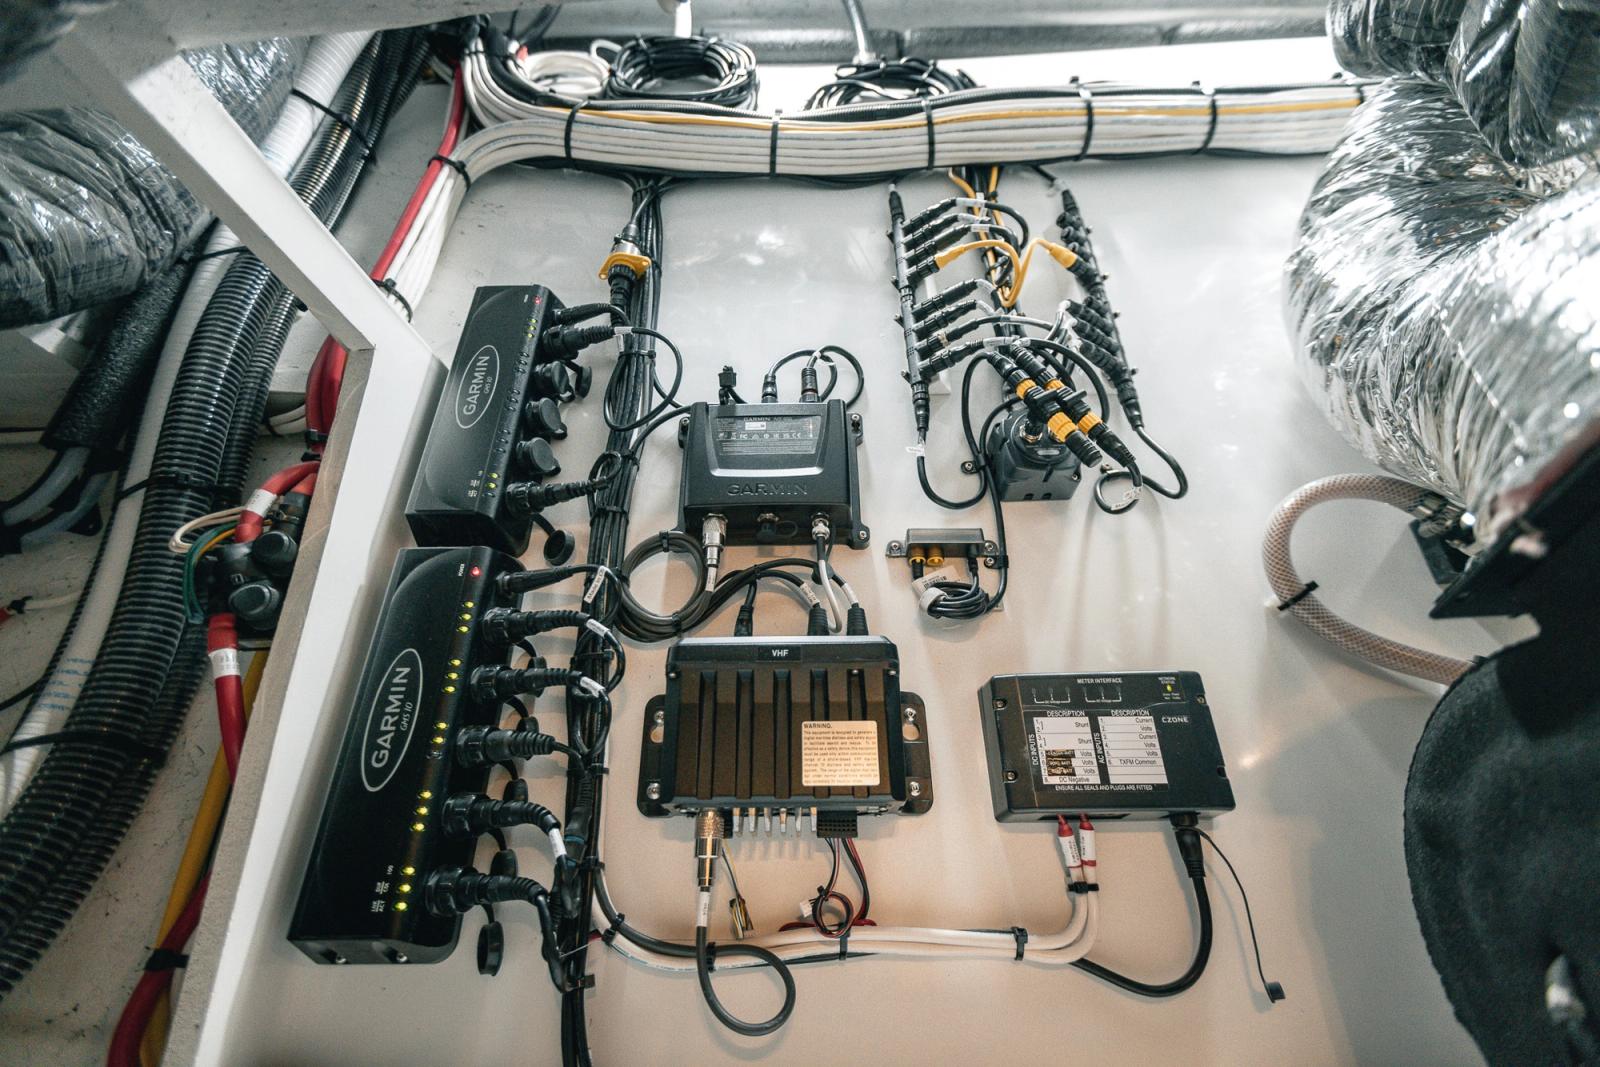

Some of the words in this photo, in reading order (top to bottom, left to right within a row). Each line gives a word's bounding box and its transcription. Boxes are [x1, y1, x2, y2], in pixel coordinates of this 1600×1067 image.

[463, 356, 490, 415] GARMIN
[728, 483, 808, 496] GARMIN
[404, 701, 413, 712] 10
[371, 667, 411, 768] GARMIN
[400, 712, 410, 732] GMS
[1032, 756, 1038, 765] DC
[1098, 754, 1105, 764] AC
